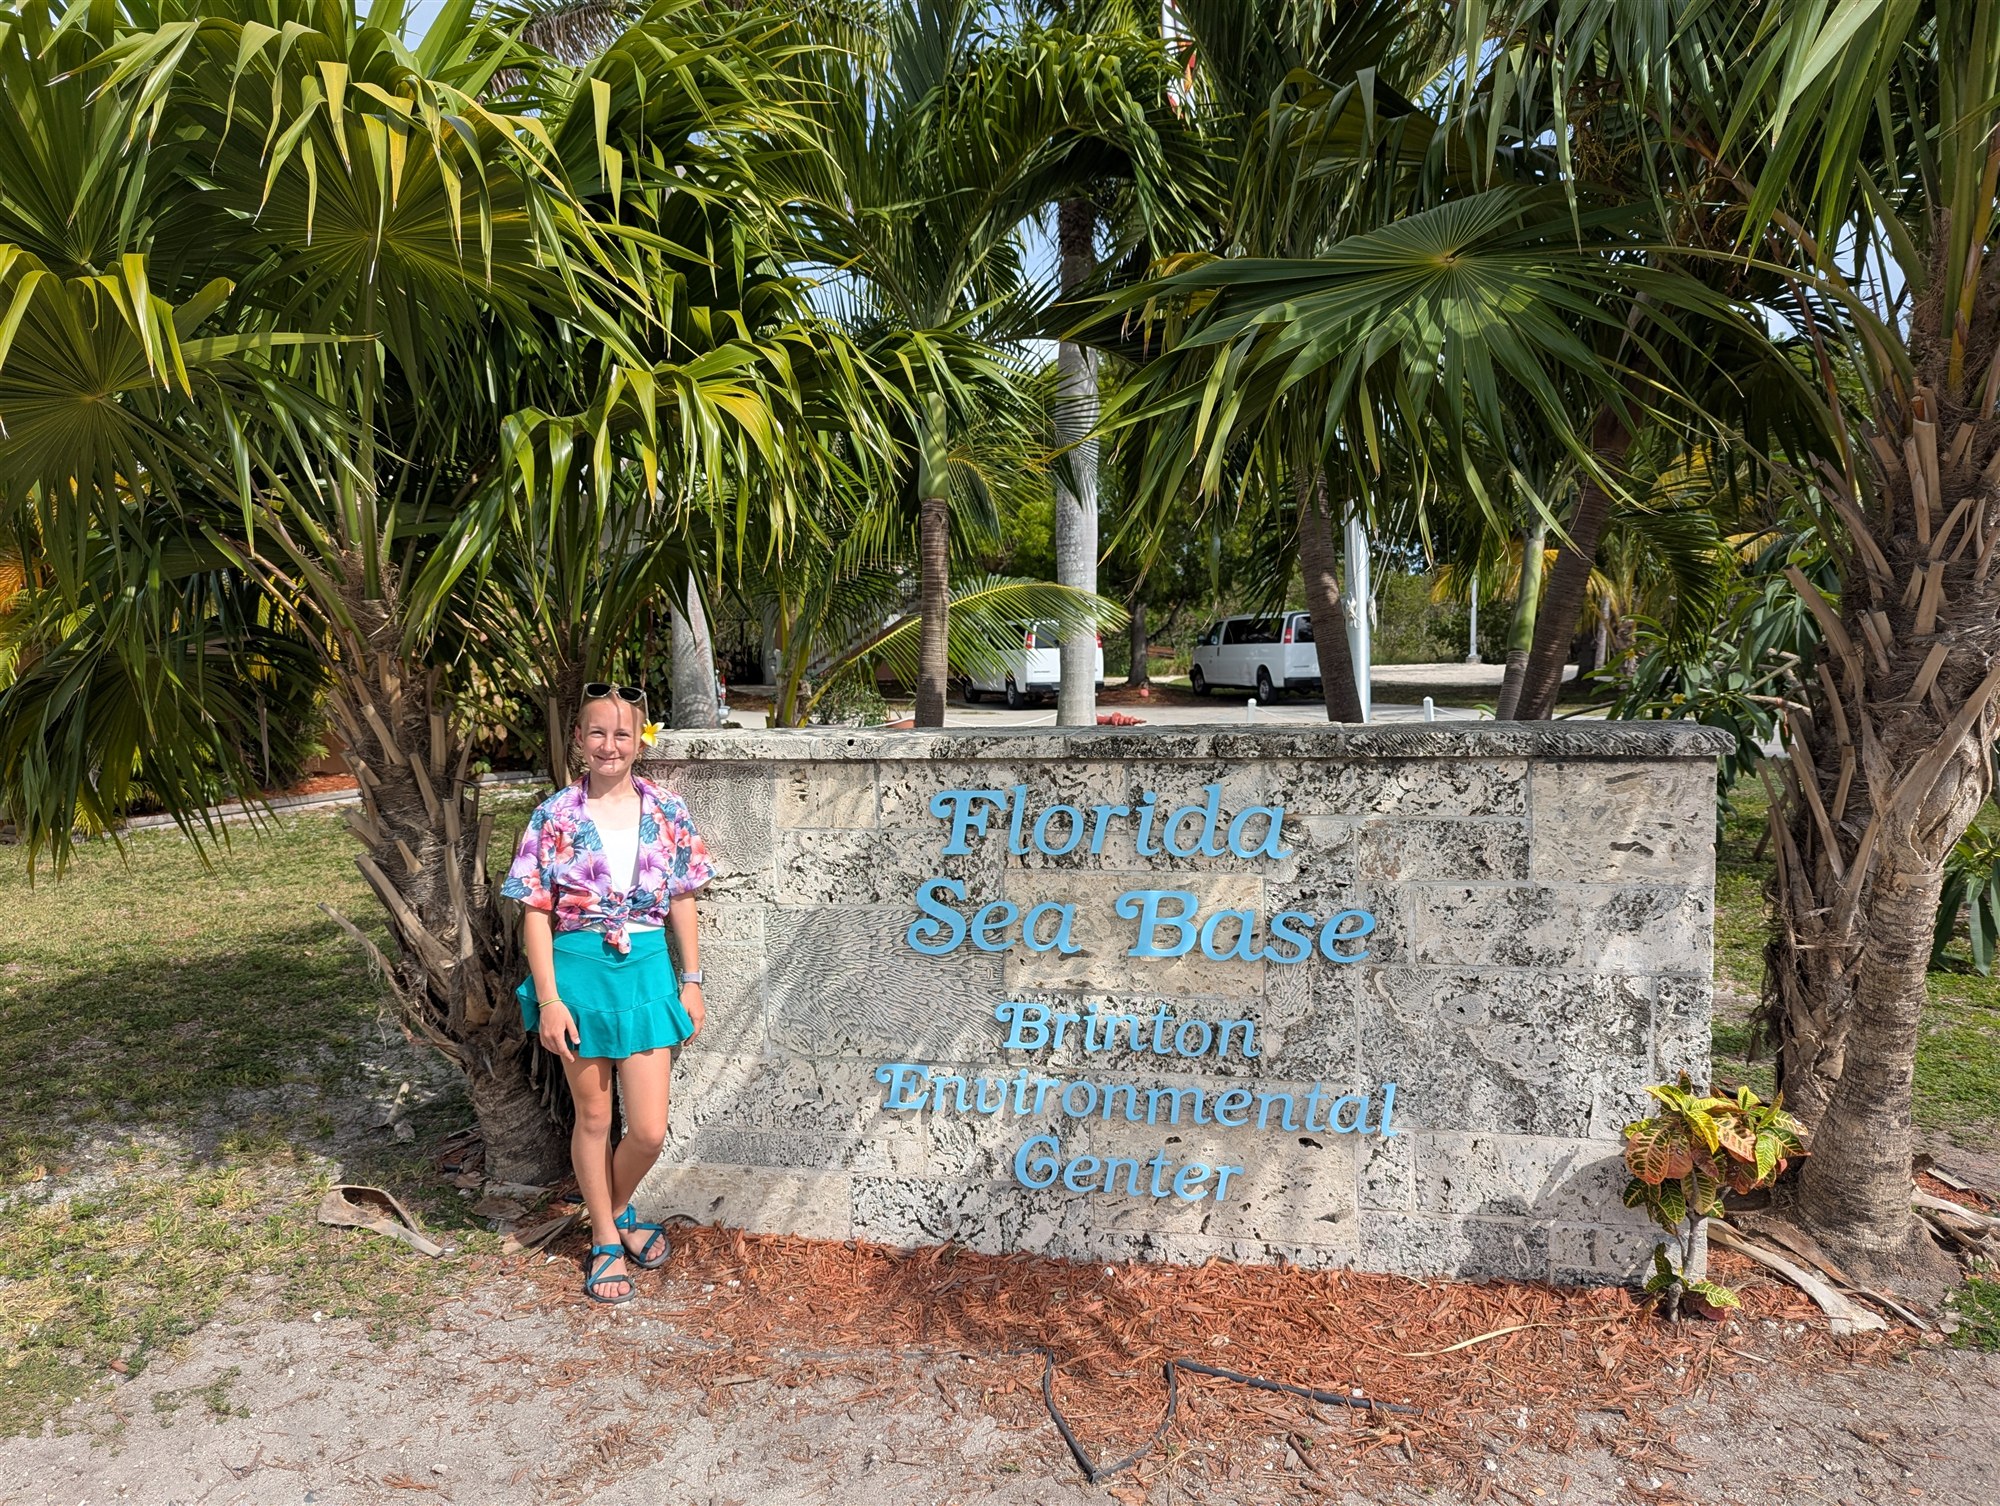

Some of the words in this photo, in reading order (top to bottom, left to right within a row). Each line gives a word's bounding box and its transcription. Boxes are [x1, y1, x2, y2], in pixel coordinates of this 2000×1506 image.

[930, 784, 1293, 860] Florida
[906, 877, 1082, 957] Sea
[1116, 889, 1377, 964] Base
[995, 1001, 1261, 1058] Brinton
[875, 1063, 1400, 1137] Environmental
[1014, 1134, 1245, 1201] Center
